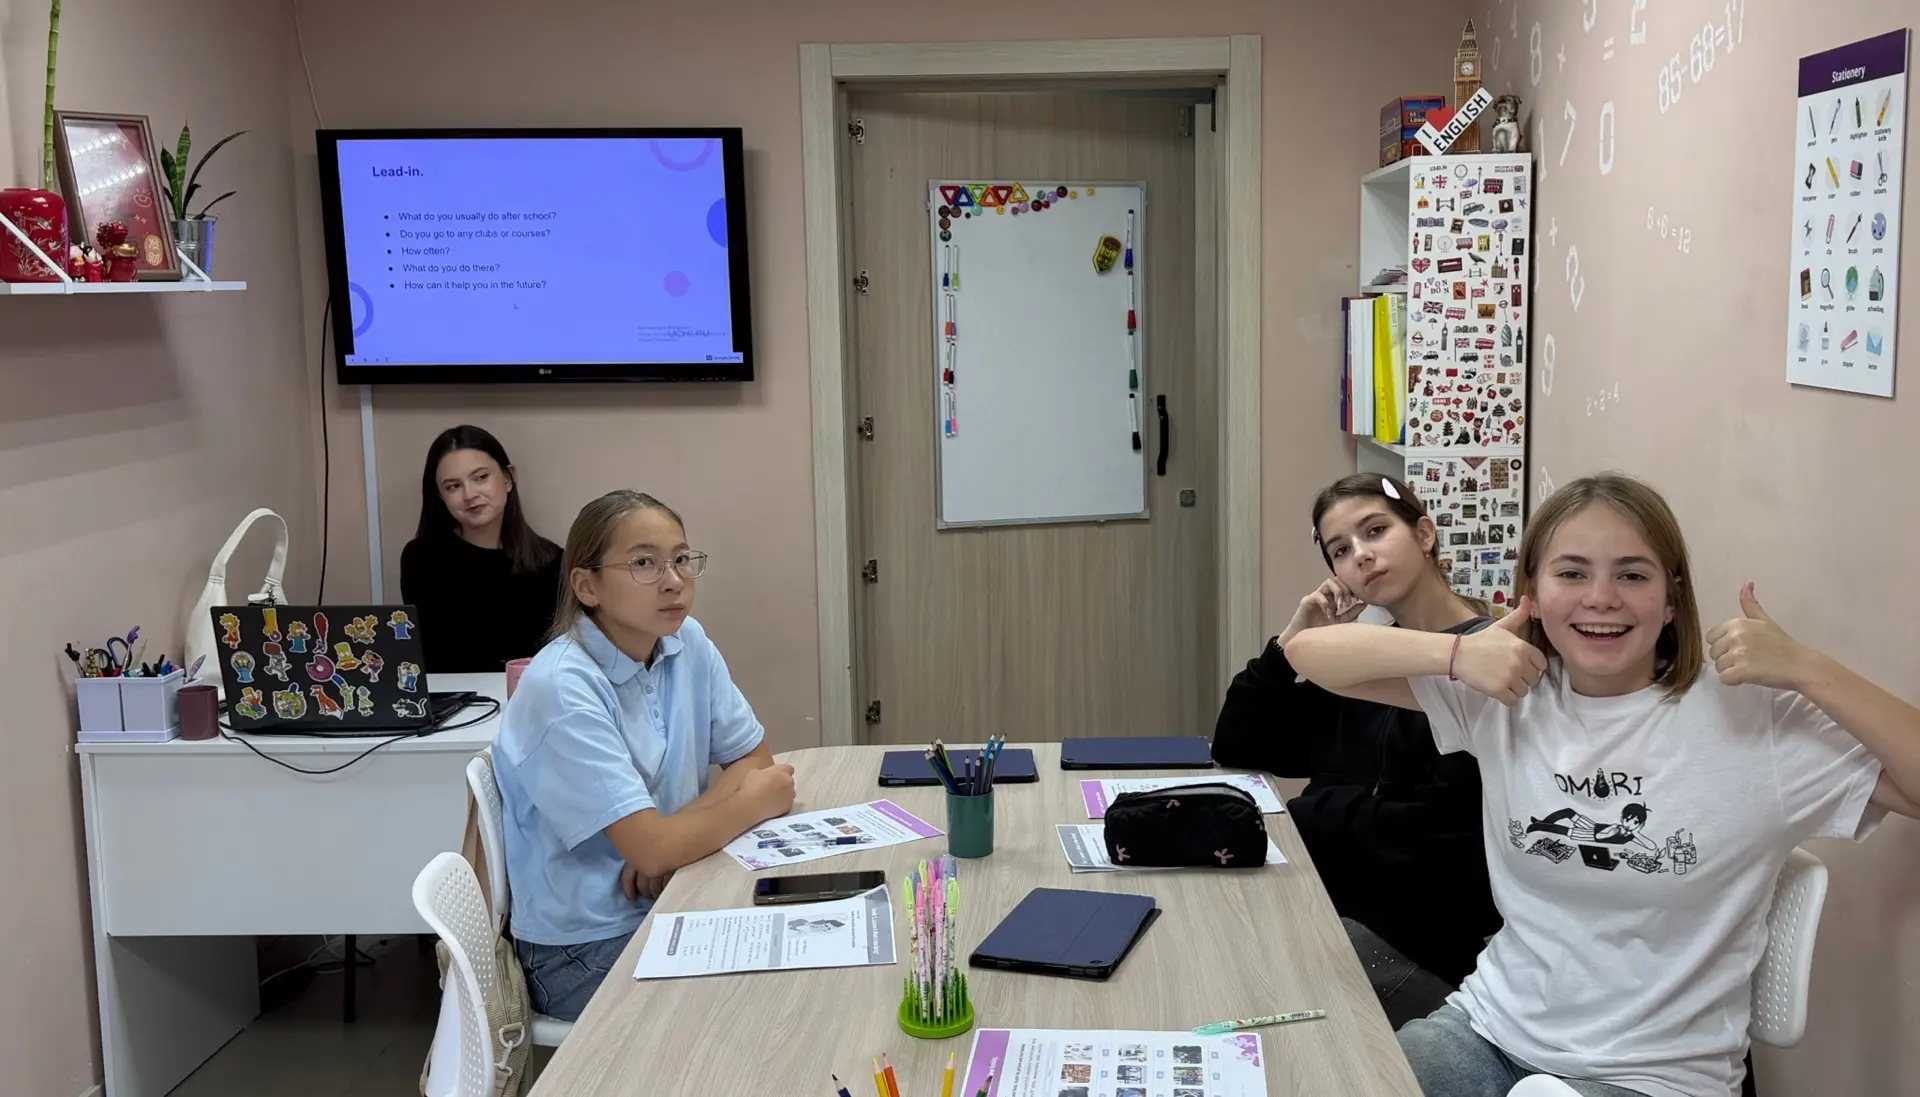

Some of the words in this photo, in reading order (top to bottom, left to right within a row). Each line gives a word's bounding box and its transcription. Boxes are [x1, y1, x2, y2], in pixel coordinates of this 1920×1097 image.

[1832, 66, 1866, 83] Stationery
[1422, 129, 1432, 140] I
[1433, 94, 1488, 152] ENGLISH
[372, 166, 424, 177] Lead-in.
[437, 214, 453, 222] you
[456, 212, 485, 222] usually
[502, 212, 521, 220] after
[524, 212, 556, 220] school?
[400, 230, 413, 238] Do
[415, 231, 431, 240] you
[433, 231, 444, 240] go
[446, 230, 455, 238] to
[457, 231, 473, 240] any
[475, 230, 498, 238] clubs
[512, 229, 551, 238] courses?
[402, 247, 421, 255] How
[424, 246, 450, 255] often?
[473, 263, 500, 272] there?
[405, 281, 424, 289] How
[452, 281, 470, 290] help
[472, 282, 488, 290] you
[517, 280, 547, 288] future?
